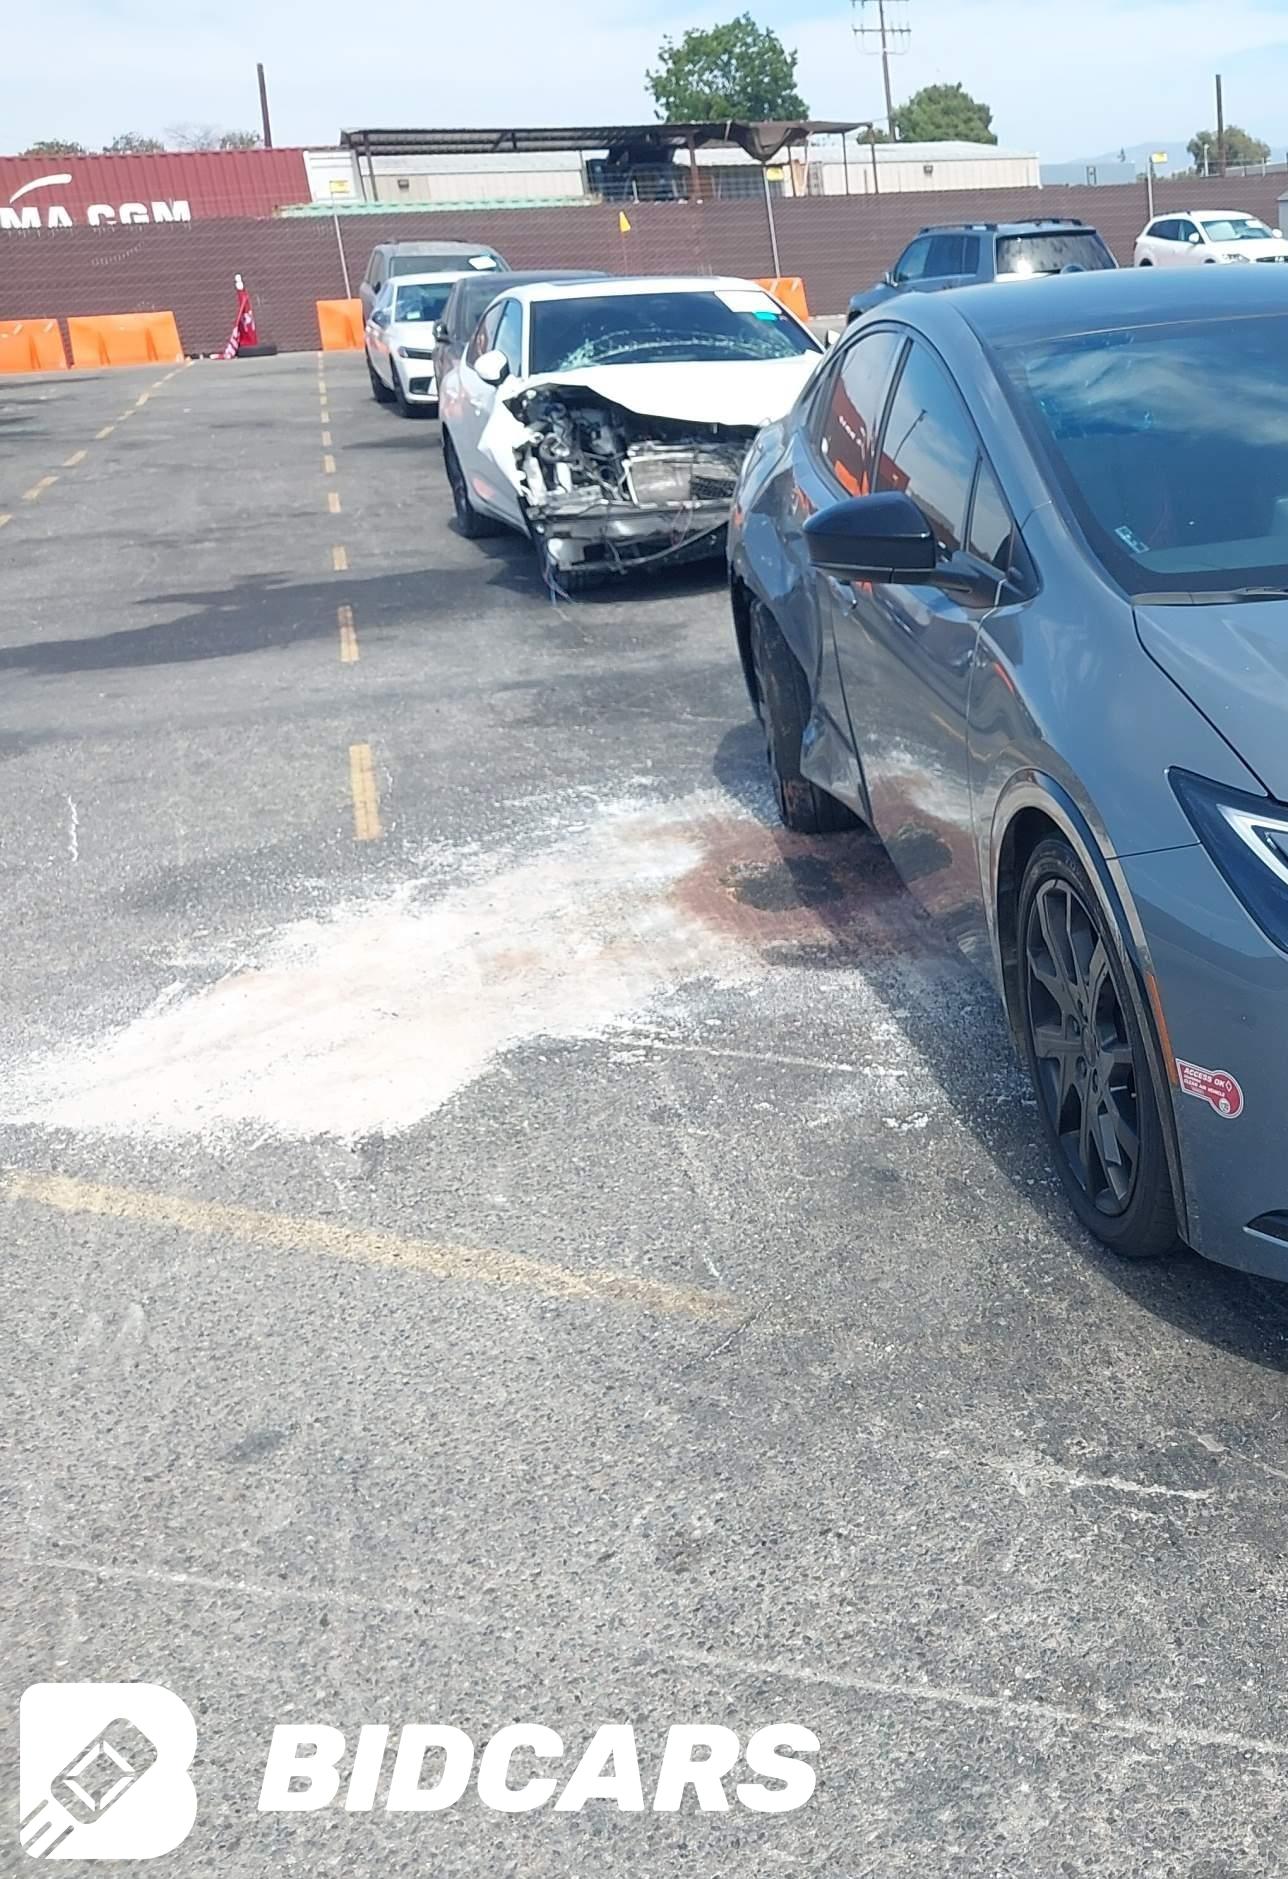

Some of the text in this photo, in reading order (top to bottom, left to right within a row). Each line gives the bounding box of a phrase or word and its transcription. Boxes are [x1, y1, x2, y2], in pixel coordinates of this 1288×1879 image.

[87, 200, 192, 227] CGM
[1184, 1066, 1213, 1083] ACCESS
[1214, 1078, 1226, 1088] OK
